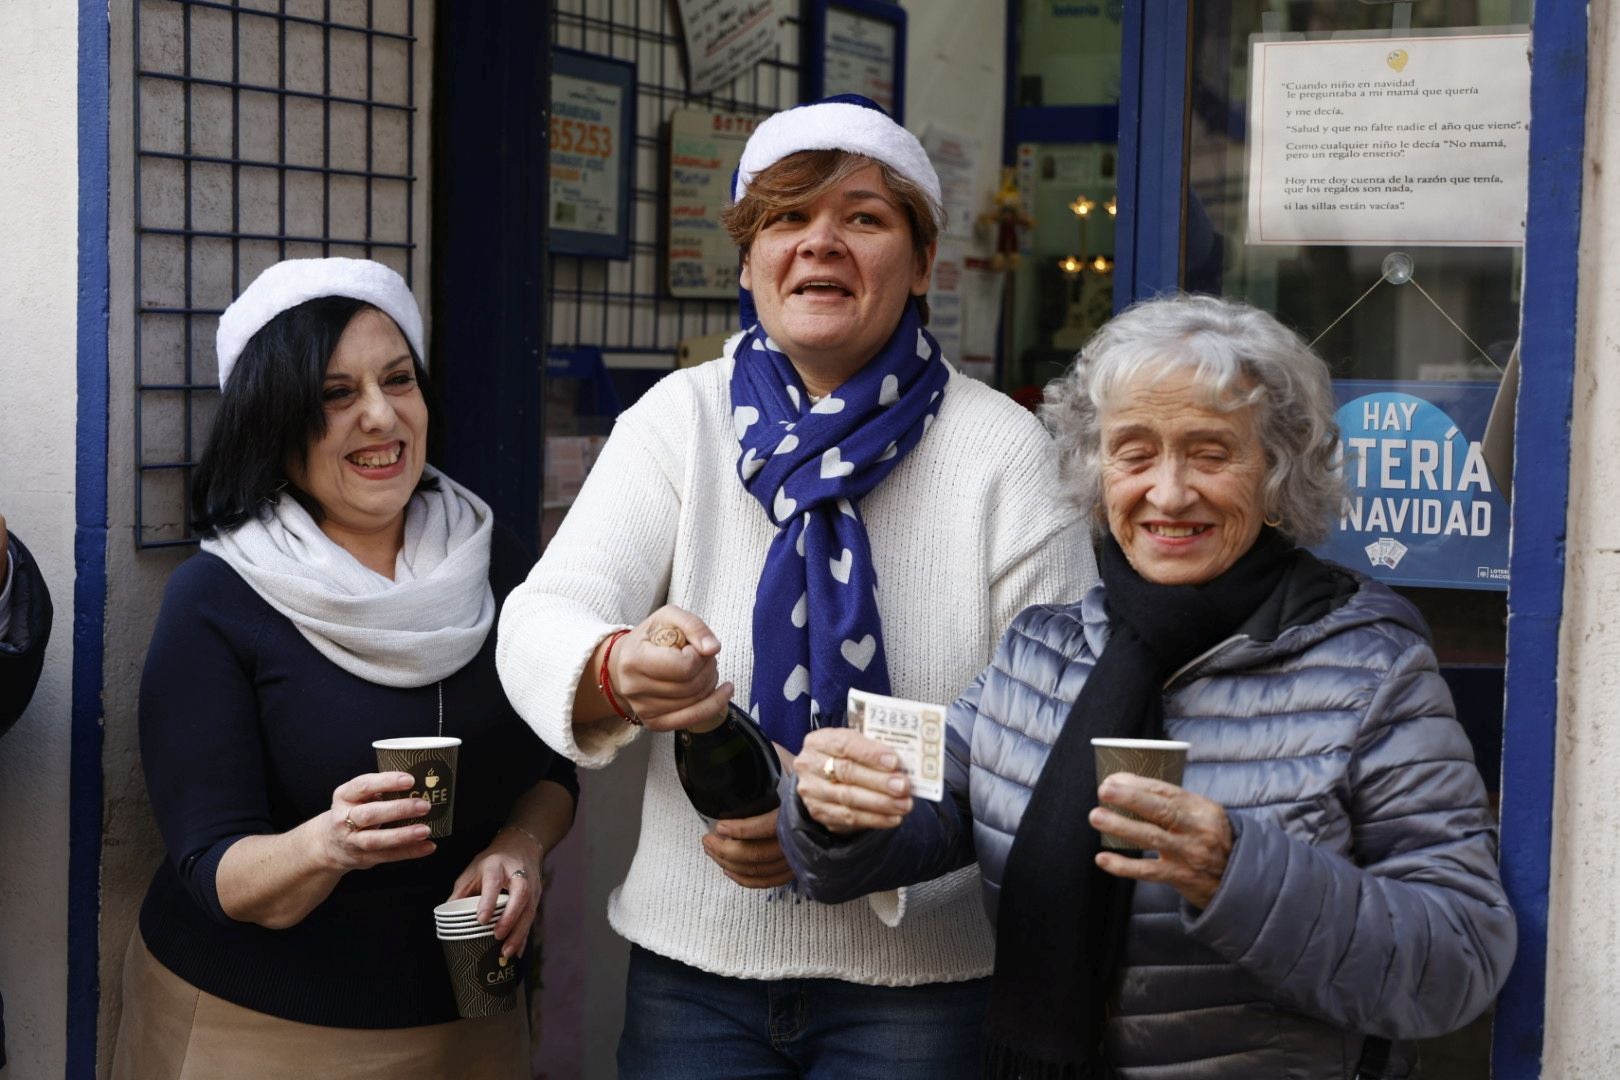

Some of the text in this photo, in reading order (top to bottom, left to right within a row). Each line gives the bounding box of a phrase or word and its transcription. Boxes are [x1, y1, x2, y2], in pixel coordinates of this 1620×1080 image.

[1331, 81, 1355, 89] niño
[1374, 79, 1415, 88] navidad
[1287, 90, 1296, 99] le
[1300, 89, 1357, 100] preguntaba
[1369, 89, 1383, 97] mi
[1386, 88, 1419, 96] mamá
[1422, 89, 1442, 98] que
[1445, 86, 1479, 97] quería
[1331, 125, 1351, 134] que
[1371, 123, 1393, 132] falte
[1396, 122, 1426, 131] nadie
[1428, 122, 1437, 131] el
[1441, 122, 1461, 130] año
[1464, 123, 1485, 132] que
[1286, 142, 1318, 150] Como
[1320, 142, 1369, 151] cualquier
[1372, 141, 1397, 149] niño
[1400, 140, 1409, 149] le
[1412, 140, 1440, 149] decía
[1286, 151, 1309, 160] pero
[1328, 150, 1360, 160] regalo
[1285, 177, 1306, 186] Hoy
[1328, 176, 1348, 186] doy
[1388, 176, 1401, 184] de
[1404, 175, 1414, 184] la
[1417, 175, 1447, 184] razón
[1450, 176, 1470, 186] que
[1284, 186, 1304, 195] que
[1306, 185, 1321, 193] los
[1324, 185, 1360, 195] regalos
[1284, 202, 1292, 210] si
[1295, 202, 1309, 210] las
[1311, 202, 1337, 210] sillas
[1339, 202, 1366, 210] están
[1363, 401, 1418, 432] HAY
[1340, 496, 1492, 537] NAVIDAD
[870, 707, 919, 731] 72853
